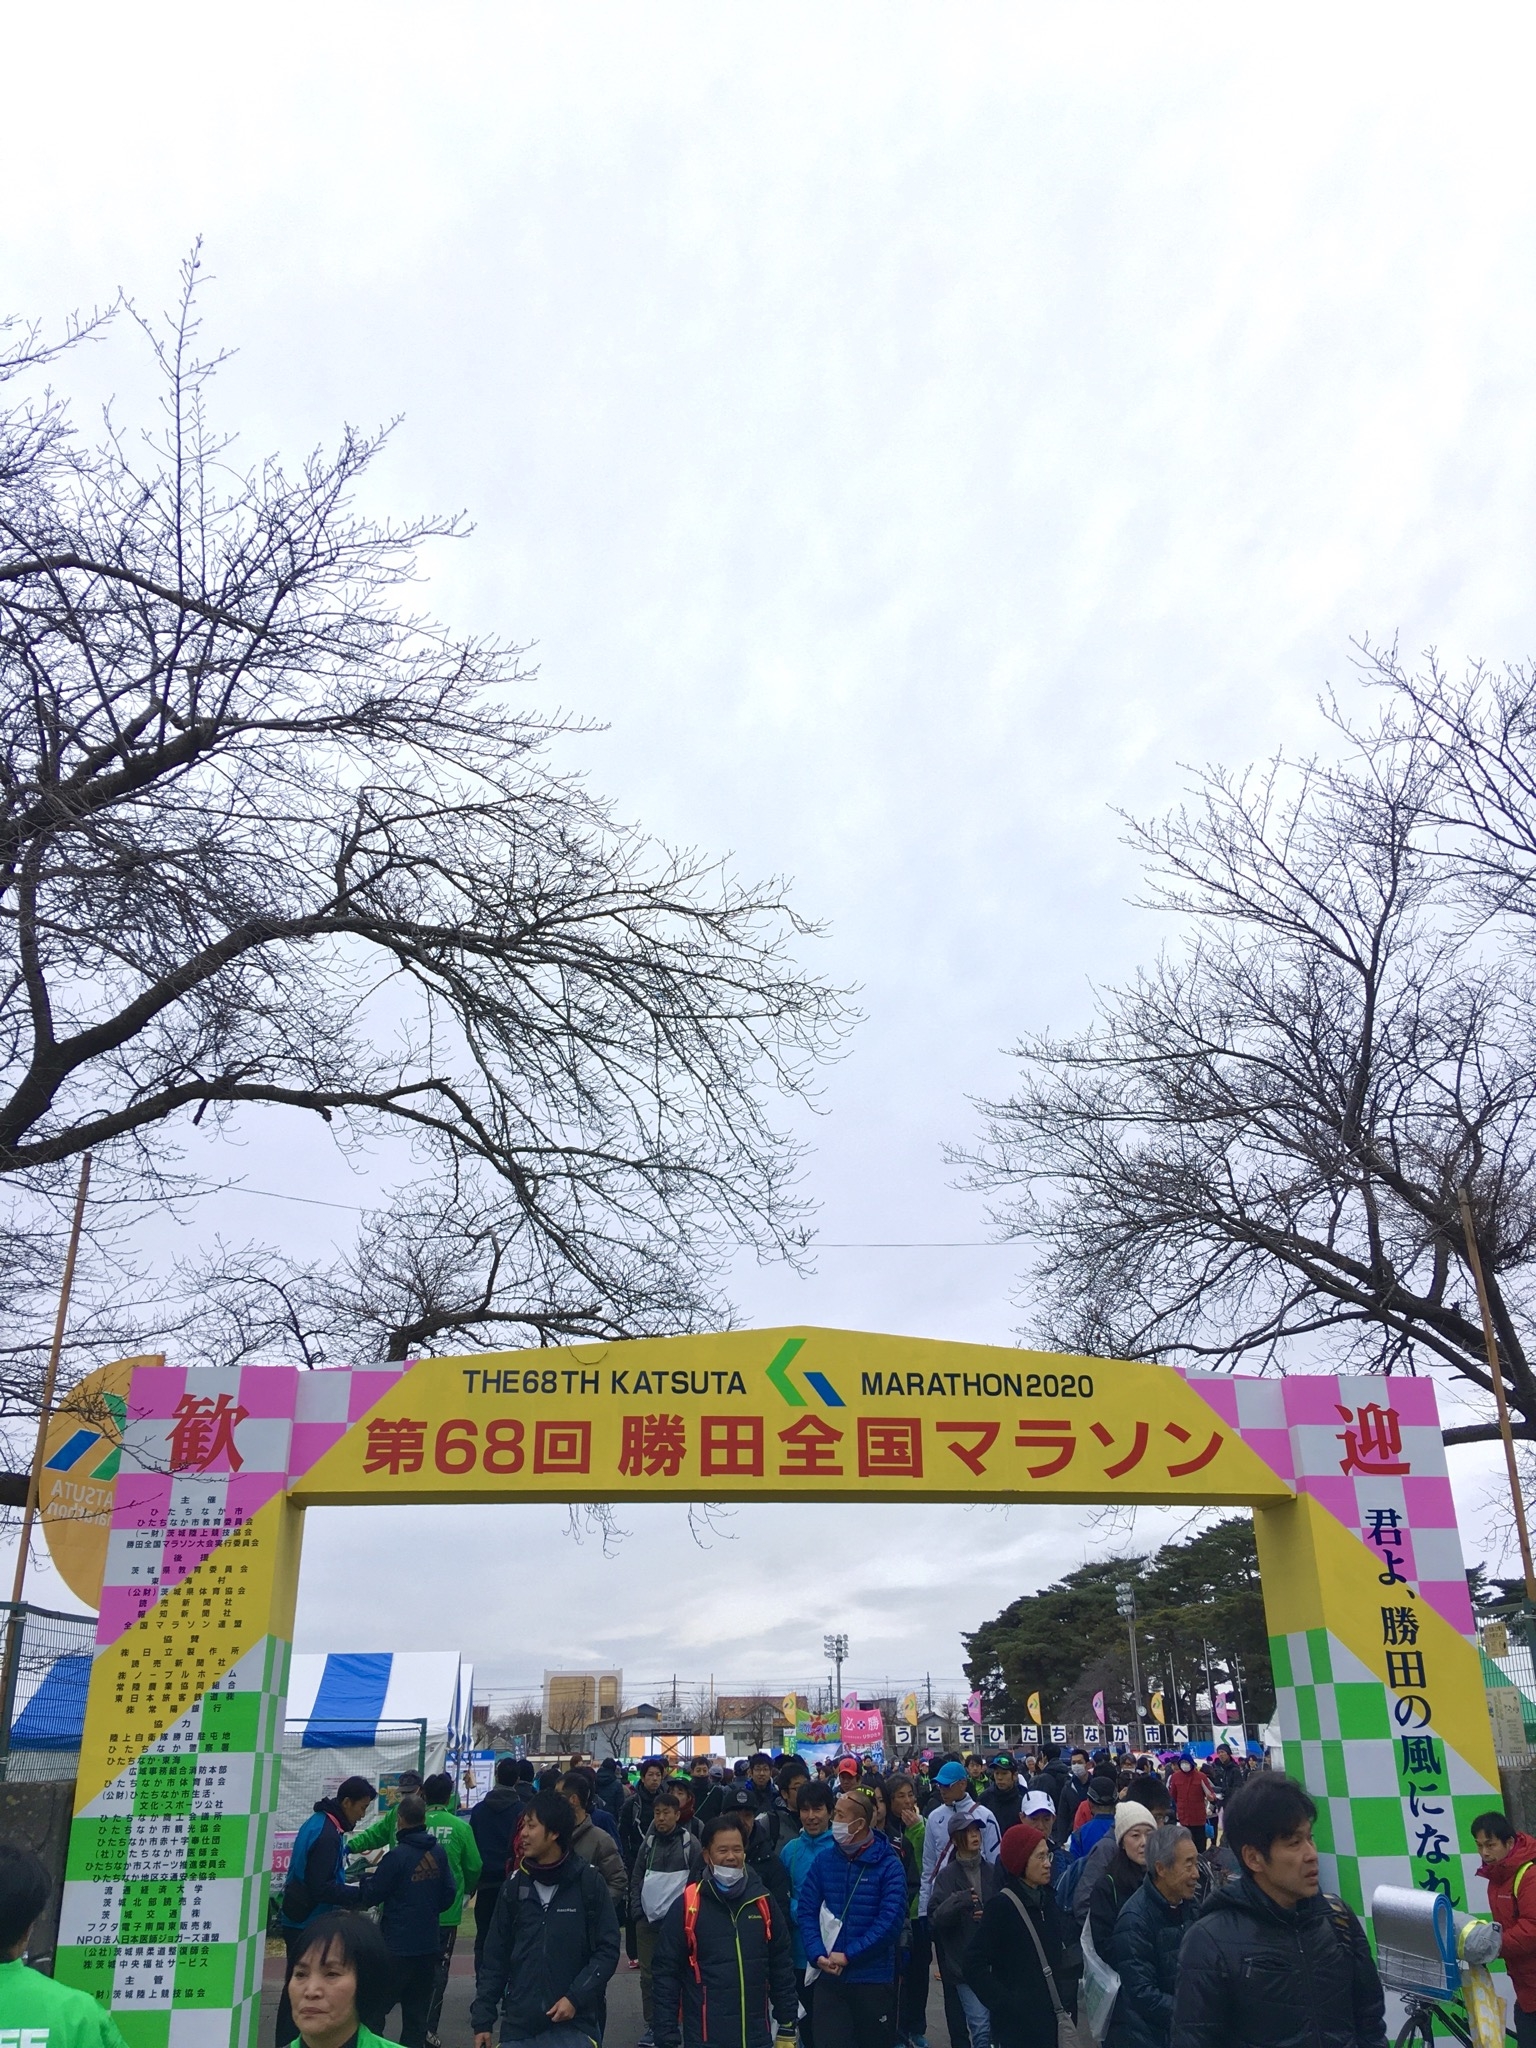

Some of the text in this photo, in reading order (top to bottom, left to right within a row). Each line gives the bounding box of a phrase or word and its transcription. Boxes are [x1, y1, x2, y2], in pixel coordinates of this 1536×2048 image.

[462, 1369, 1094, 1398] THE68TH KATSUTA MARATHON2020
[165, 1393, 250, 1474] 歓
[1333, 1402, 1411, 1477] 迎
[362, 1413, 1224, 1479] 第68回 勝田全国マラソン
[180, 1496, 216, 1504] 主催
[151, 1507, 243, 1516] ひたちなか市
[137, 1518, 253, 1527] ひたちなか市教育委員会
[126, 1539, 259, 1549] 勝田全国マラソン大会実行委員会
[131, 1565, 248, 1575] 茨城県教育委員会
[151, 1576, 226, 1585] 東海村
[138, 1598, 233, 1608] 読売新聞社
[137, 1609, 231, 1618] 報知新聞社
[124, 1619, 242, 1630] 全国マラソン連盟
[131, 1658, 226, 1668] 読売新聞社
[153, 1720, 191, 1728] 協力
[109, 1732, 231, 1742] 陸上自衛隊勝田駐屯地
[104, 1777, 226, 1788] ひたちなか市体育協会
[98, 1823, 222, 1835] ひたちなか市観光協会
[426, 1825, 453, 1839] AFF
[85, 1859, 226, 1871] ひたちなか市スポーツ推進委員会
[92, 1872, 217, 1883] ひたちなか地区交通安全協会
[104, 1884, 203, 1895] 流通経済大学
[124, 1975, 164, 1986] 主管
[91, 1988, 206, 1999] 財)茨城陸上競技協会
